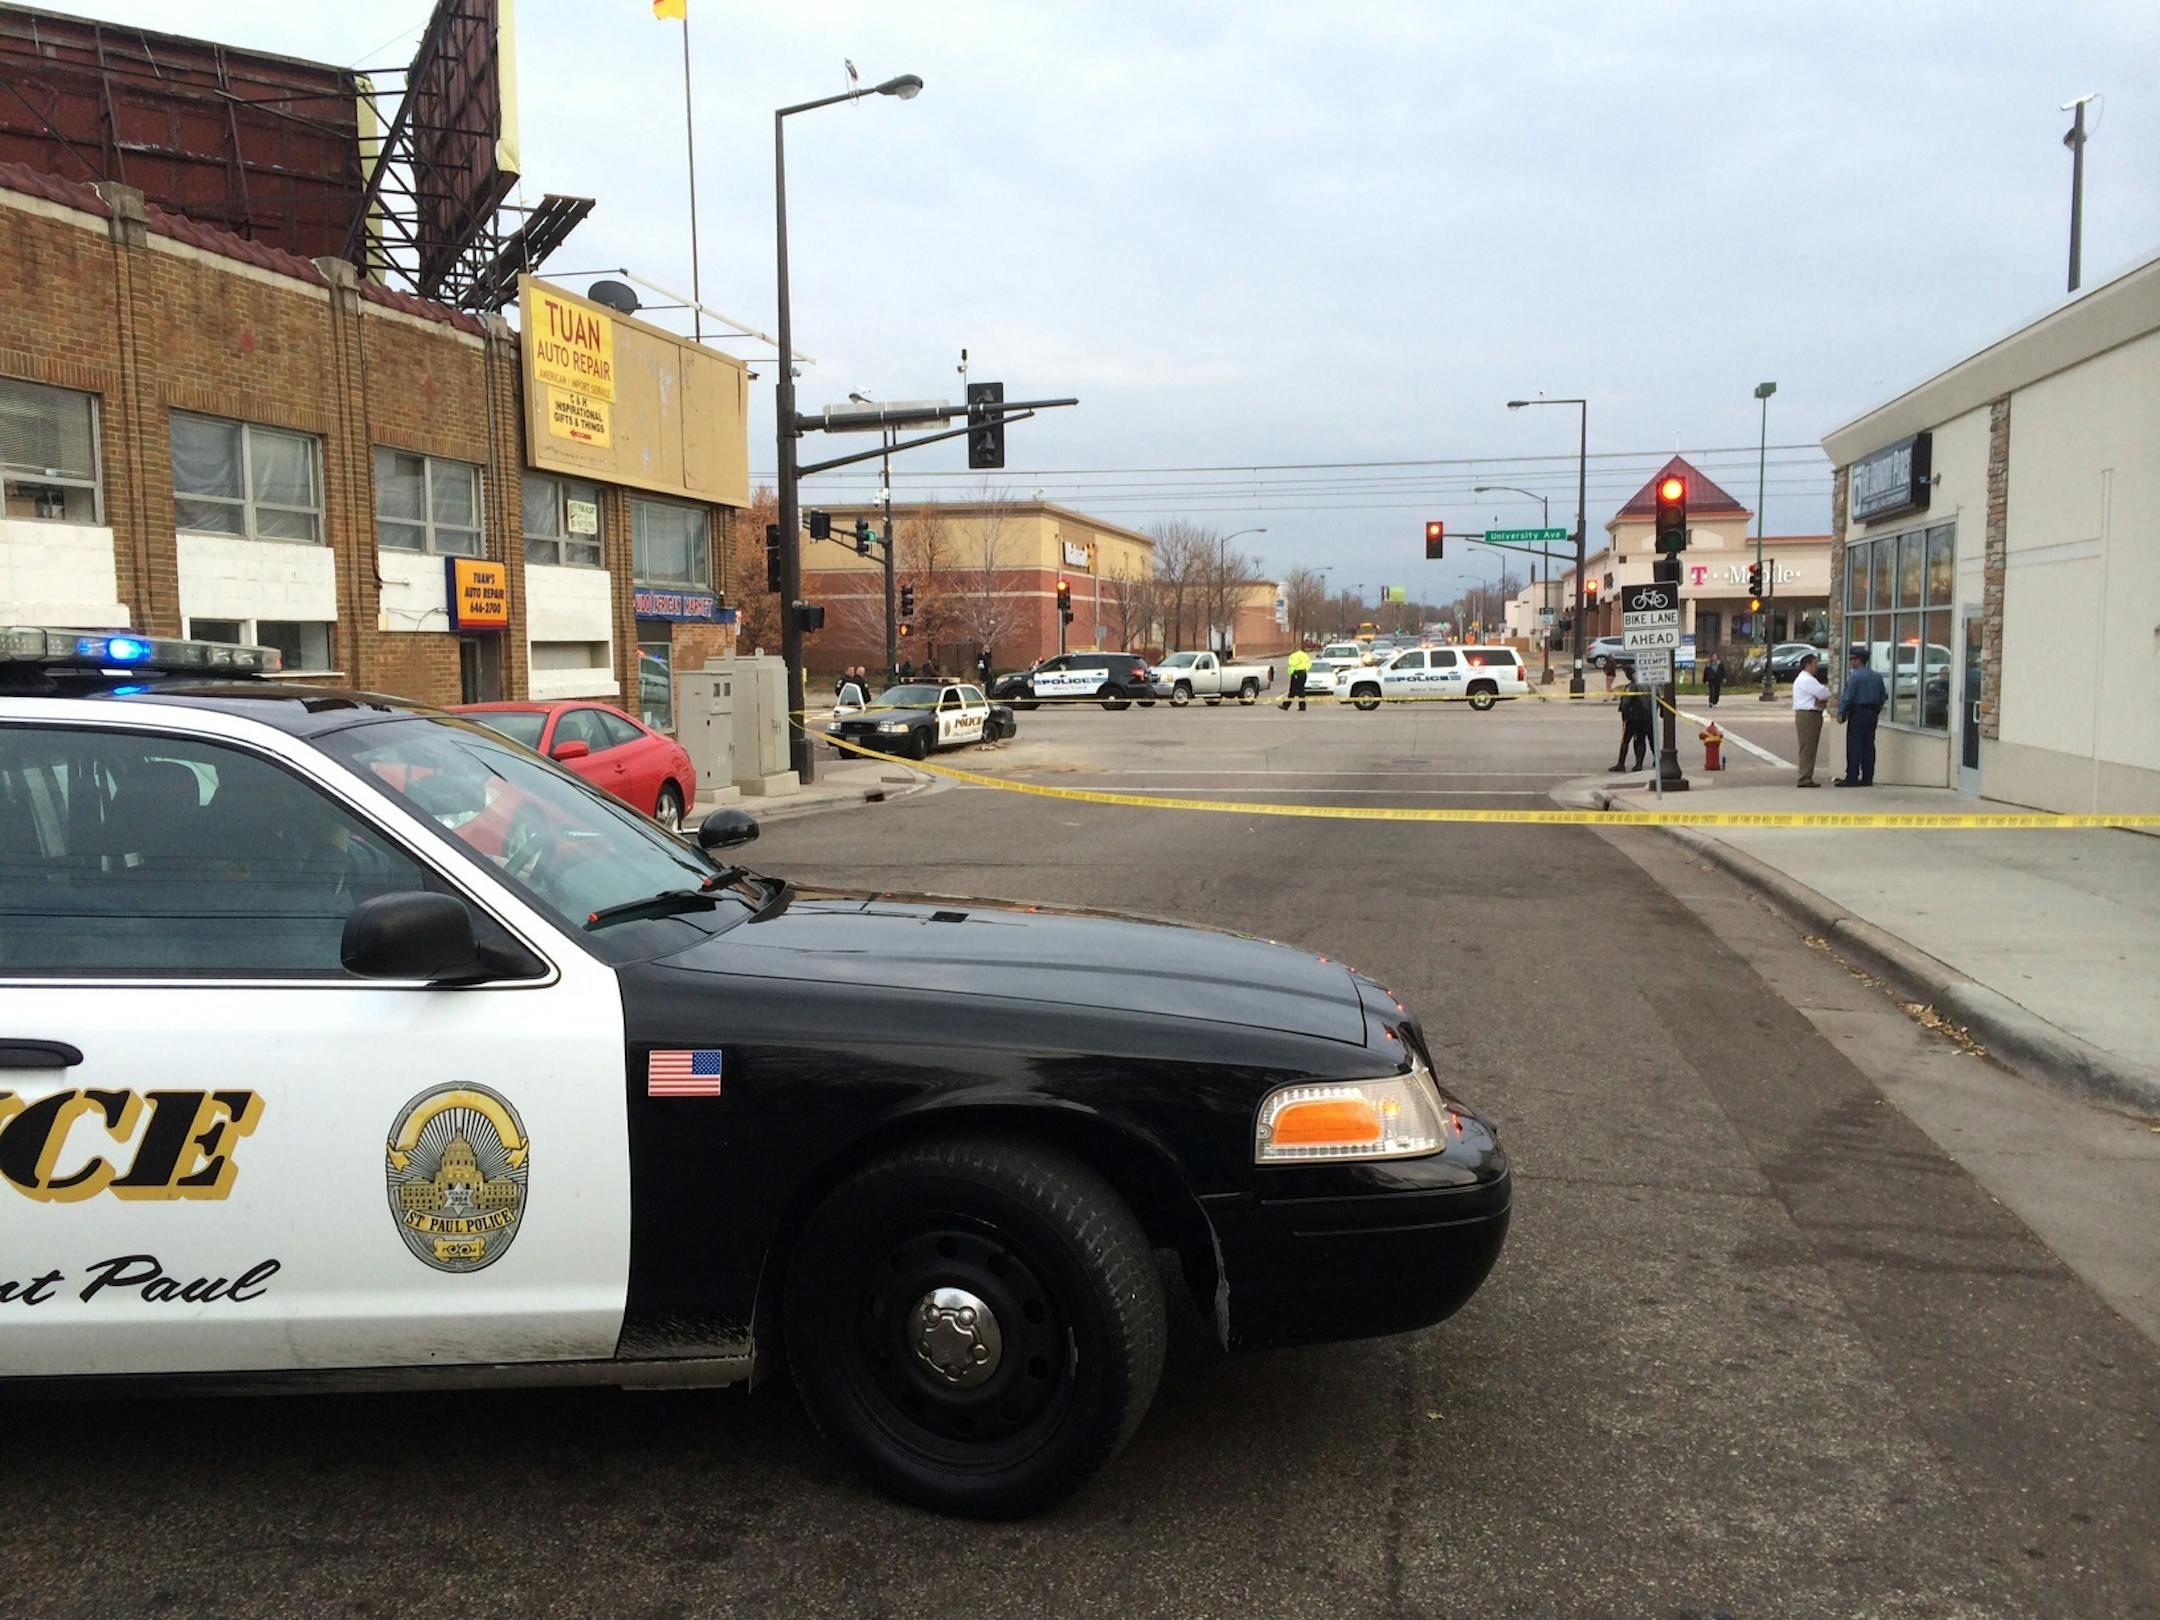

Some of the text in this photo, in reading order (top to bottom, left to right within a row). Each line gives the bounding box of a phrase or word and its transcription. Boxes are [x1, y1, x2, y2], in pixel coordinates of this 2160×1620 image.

[544, 300, 600, 353] TUAN
[537, 339, 611, 382] AUTO REPAIR
[553, 411, 573, 426] GIFTS
[580, 418, 605, 434] THINGS
[554, 399, 604, 423] INSPIRATIONAL
[1490, 531, 1561, 541] University Ave
[464, 586, 504, 599] AUTO REPAIR
[654, 594, 681, 615] AFRICAN
[683, 596, 713, 617] MARKET
[1624, 612, 1677, 626] BIKE LANE
[1630, 632, 1674, 646] AHEAD
[1396, 675, 1450, 683] POLICE
[954, 716, 983, 728] POLICE
[0, 1088, 266, 1203] CE
[407, 1210, 512, 1233] ST PAUL POLICE
[79, 1254, 281, 1303] Paul
